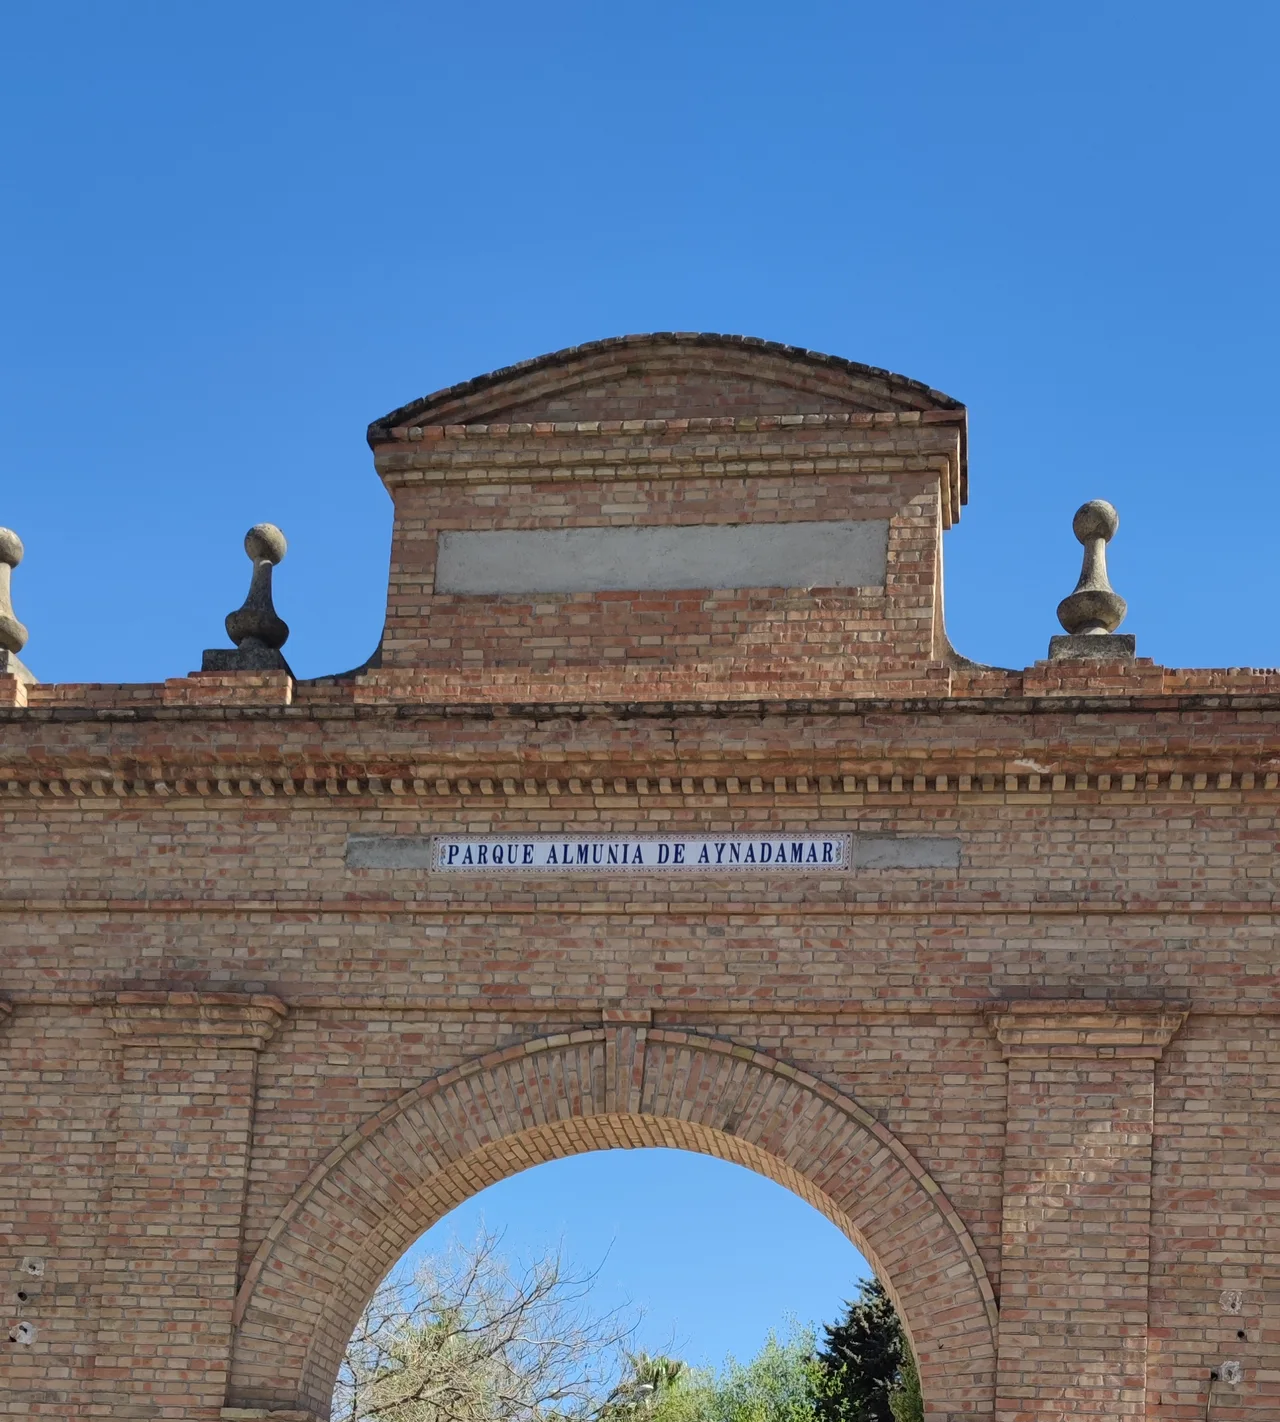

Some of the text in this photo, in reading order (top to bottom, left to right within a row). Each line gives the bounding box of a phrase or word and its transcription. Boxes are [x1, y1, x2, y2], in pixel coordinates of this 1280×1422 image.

[447, 842, 834, 865] PARQUE ALMUNIA DE AYNADAMAR
